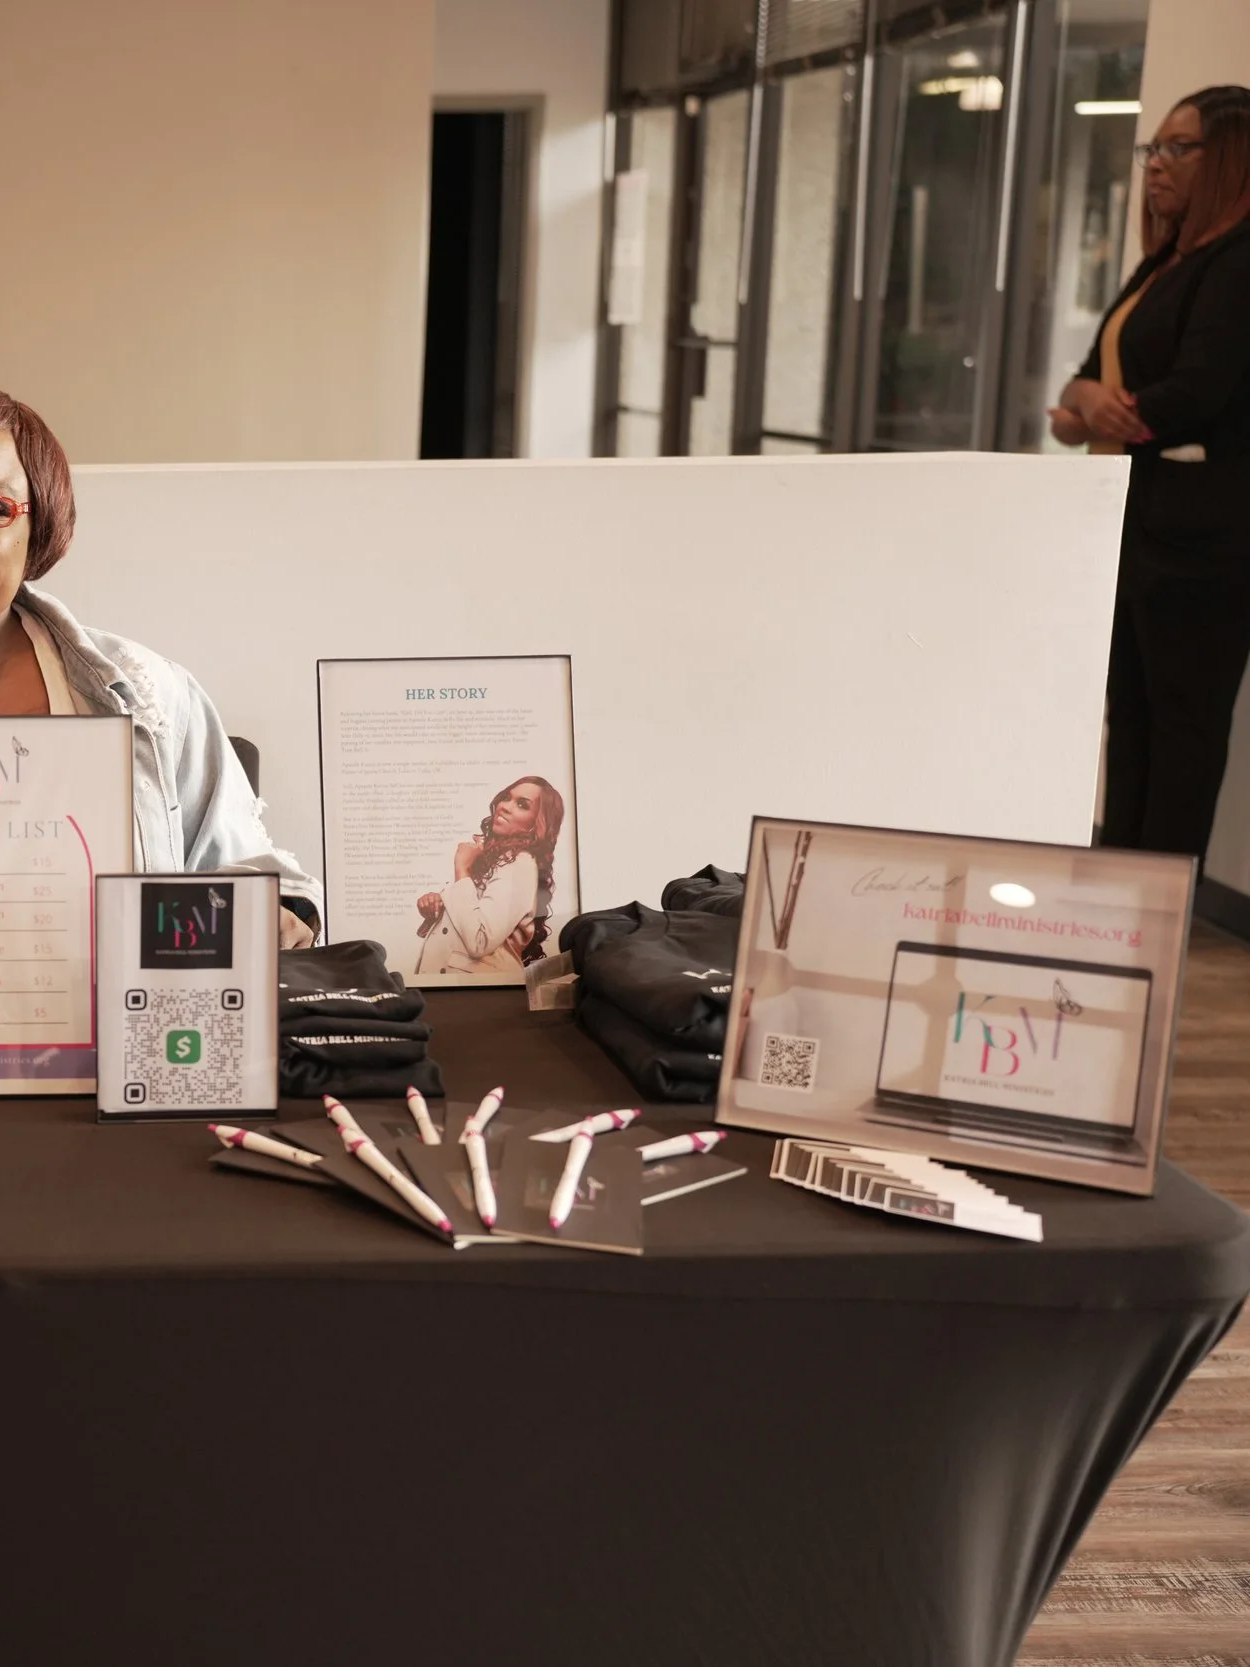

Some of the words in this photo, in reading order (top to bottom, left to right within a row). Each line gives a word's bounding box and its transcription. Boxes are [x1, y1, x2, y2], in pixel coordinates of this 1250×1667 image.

[405, 688, 436, 700] HER
[439, 687, 489, 700] STORY
[7, 820, 64, 839] LIST
[32, 857, 53, 867] $15
[32, 885, 53, 896] $25
[33, 914, 53, 925] $20
[34, 944, 53, 955] $15
[34, 976, 53, 987] $12
[34, 1008, 47, 1019] $5
[328, 1035, 353, 1044] BELL
[953, 991, 1064, 1077] KBM
